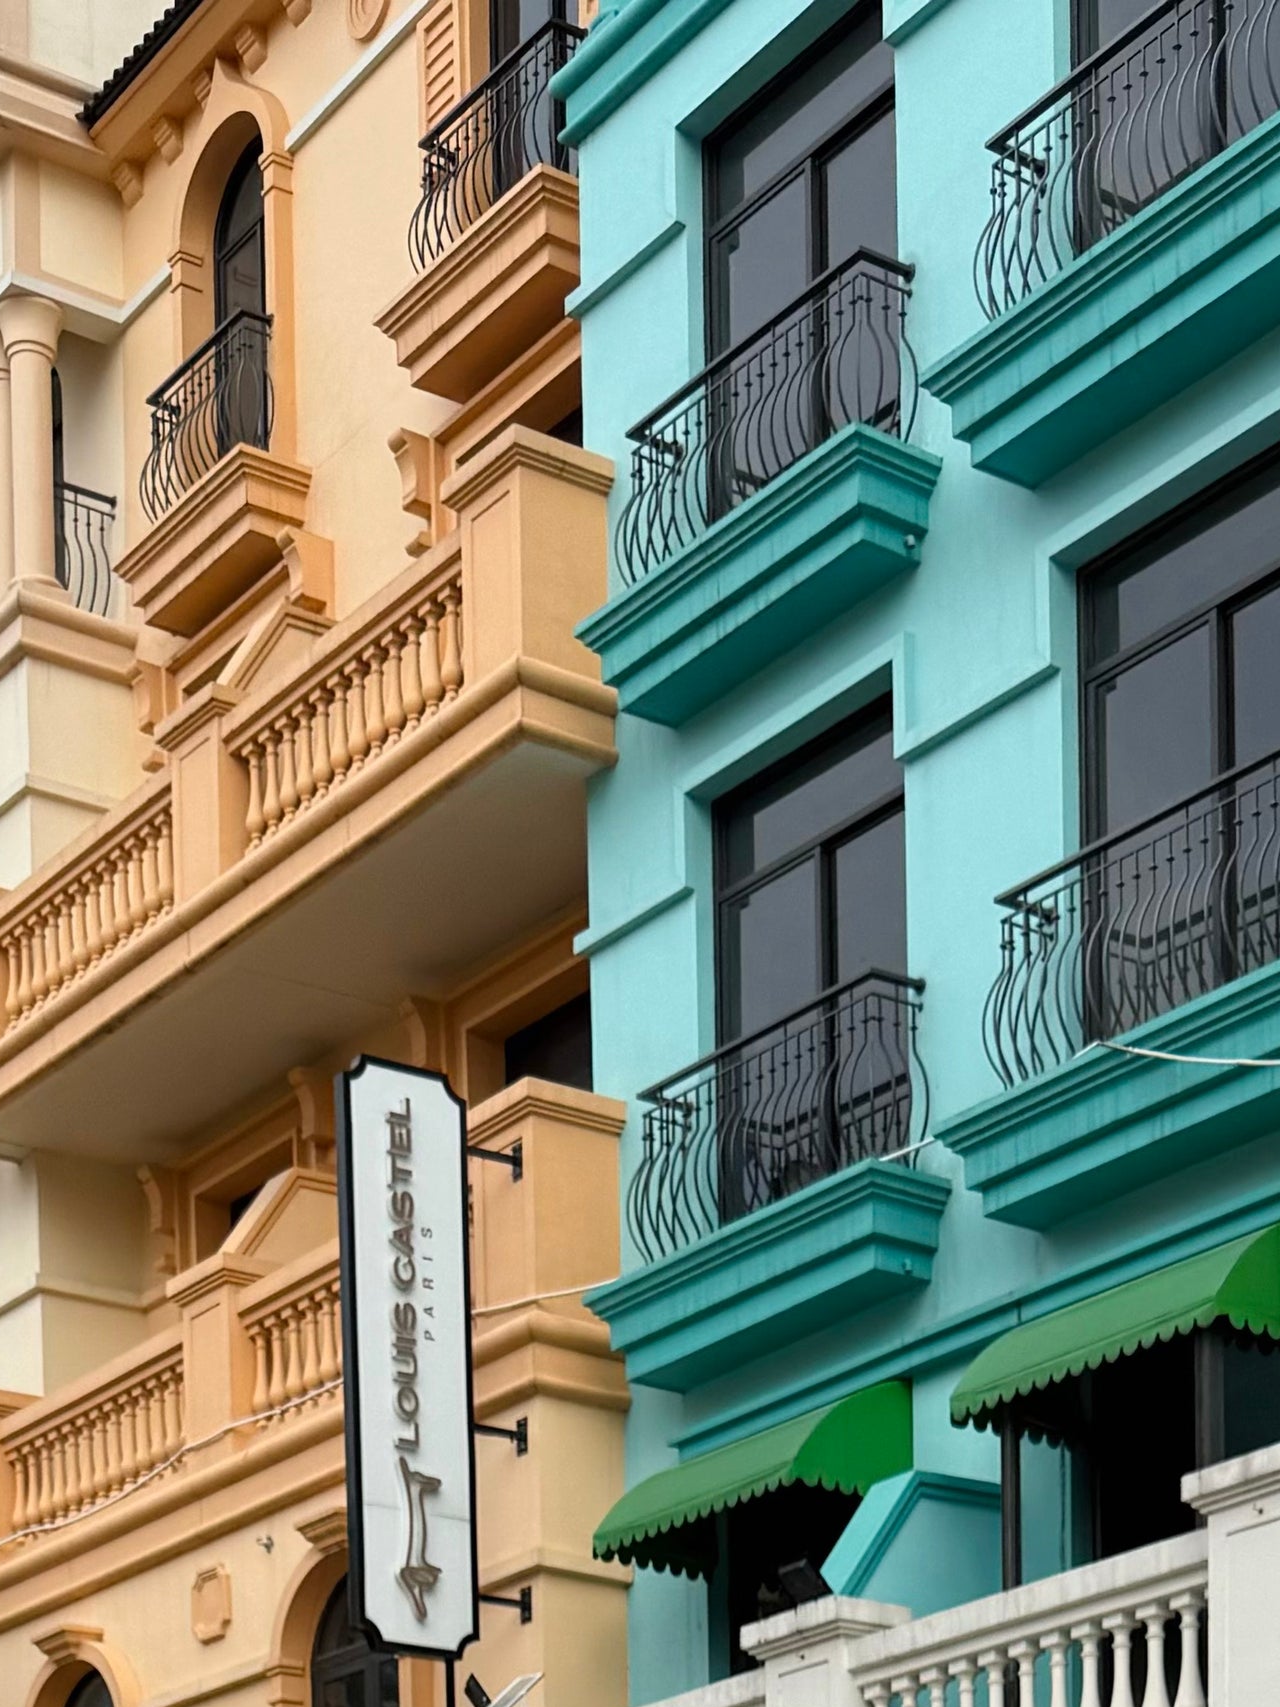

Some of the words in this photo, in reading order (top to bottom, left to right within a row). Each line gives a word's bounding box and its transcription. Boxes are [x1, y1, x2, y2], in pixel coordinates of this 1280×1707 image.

[384, 1097, 417, 1291] CASTEL
[421, 1226, 436, 1342] PARIS
[391, 1302, 422, 1453] LOUIS
